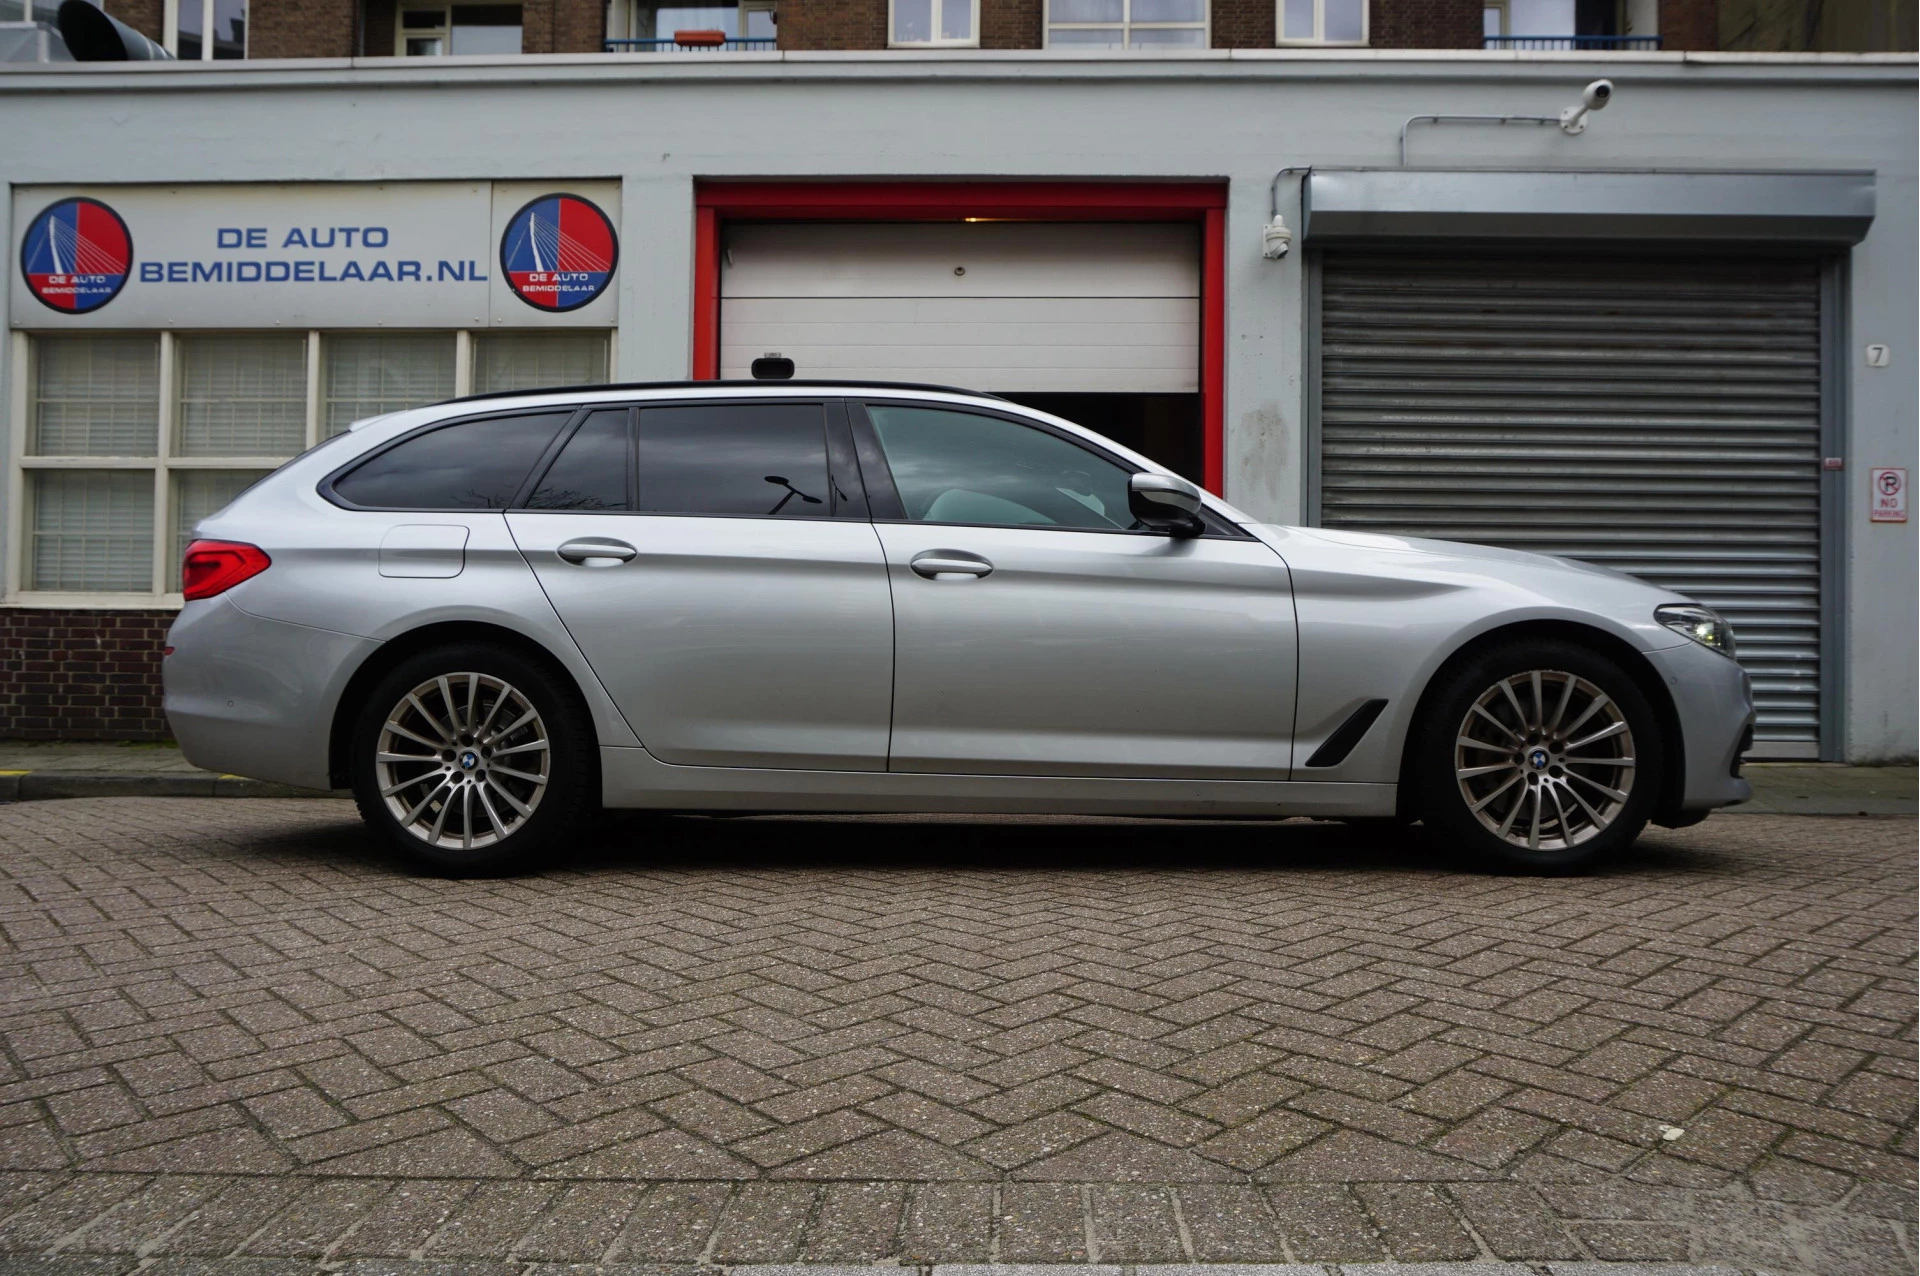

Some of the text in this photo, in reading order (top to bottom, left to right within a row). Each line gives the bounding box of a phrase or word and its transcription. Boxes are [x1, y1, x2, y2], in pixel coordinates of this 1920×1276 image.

[217, 226, 389, 249] DE AUTO
[139, 260, 489, 283] BEMIDDELAAR.NL
[529, 273, 589, 282] DE AUTO
[48, 275, 106, 284] DE AUTO
[1872, 347, 1883, 364] 7
[1881, 498, 1898, 508] NO
